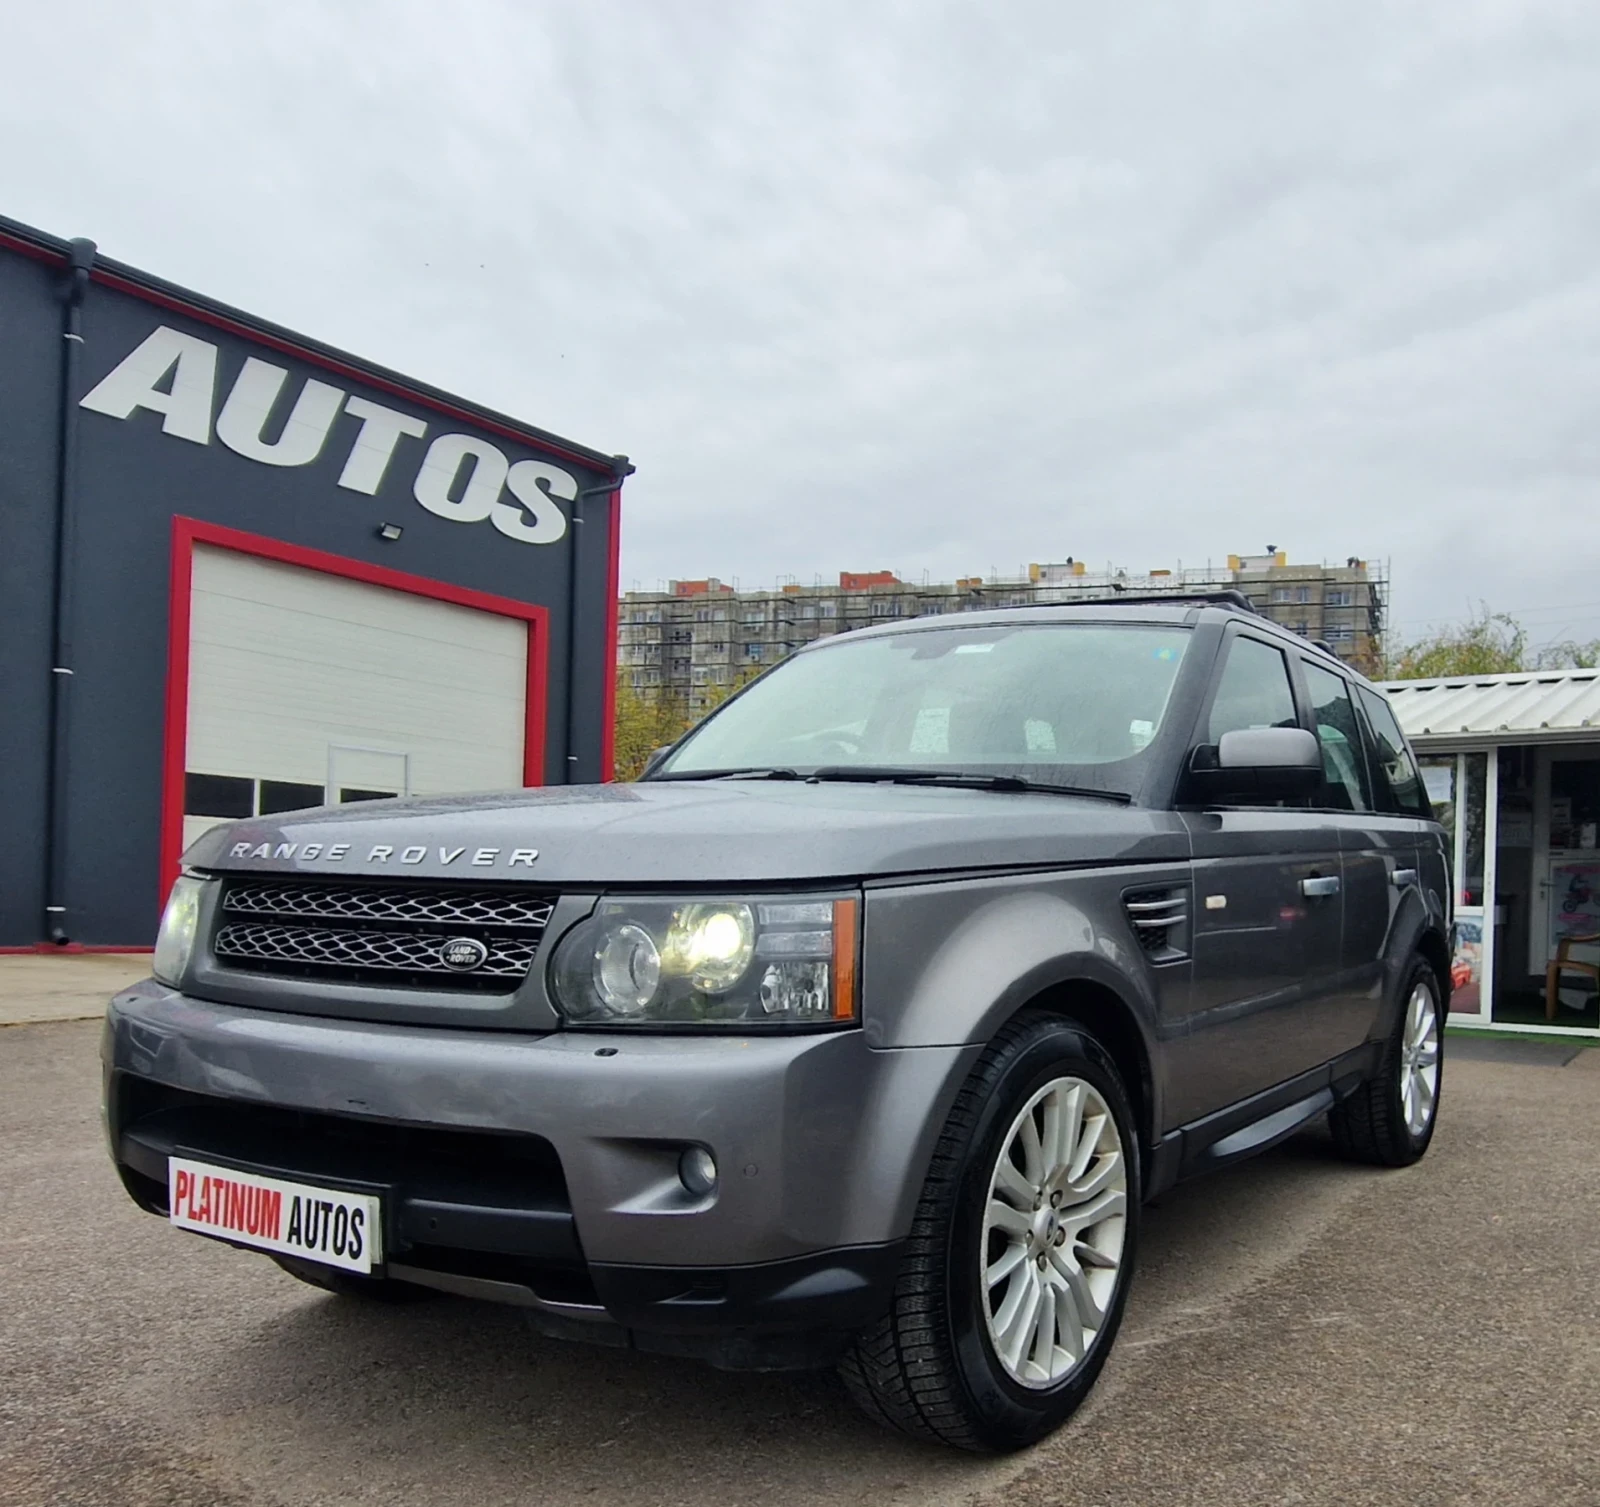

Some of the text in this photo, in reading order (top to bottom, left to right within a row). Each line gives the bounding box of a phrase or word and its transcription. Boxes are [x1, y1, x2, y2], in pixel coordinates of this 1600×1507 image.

[79, 325, 578, 544] AUTOS
[229, 842, 540, 867] RANGE ROVER
[174, 1170, 364, 1260] PLATINUM AUTOS
